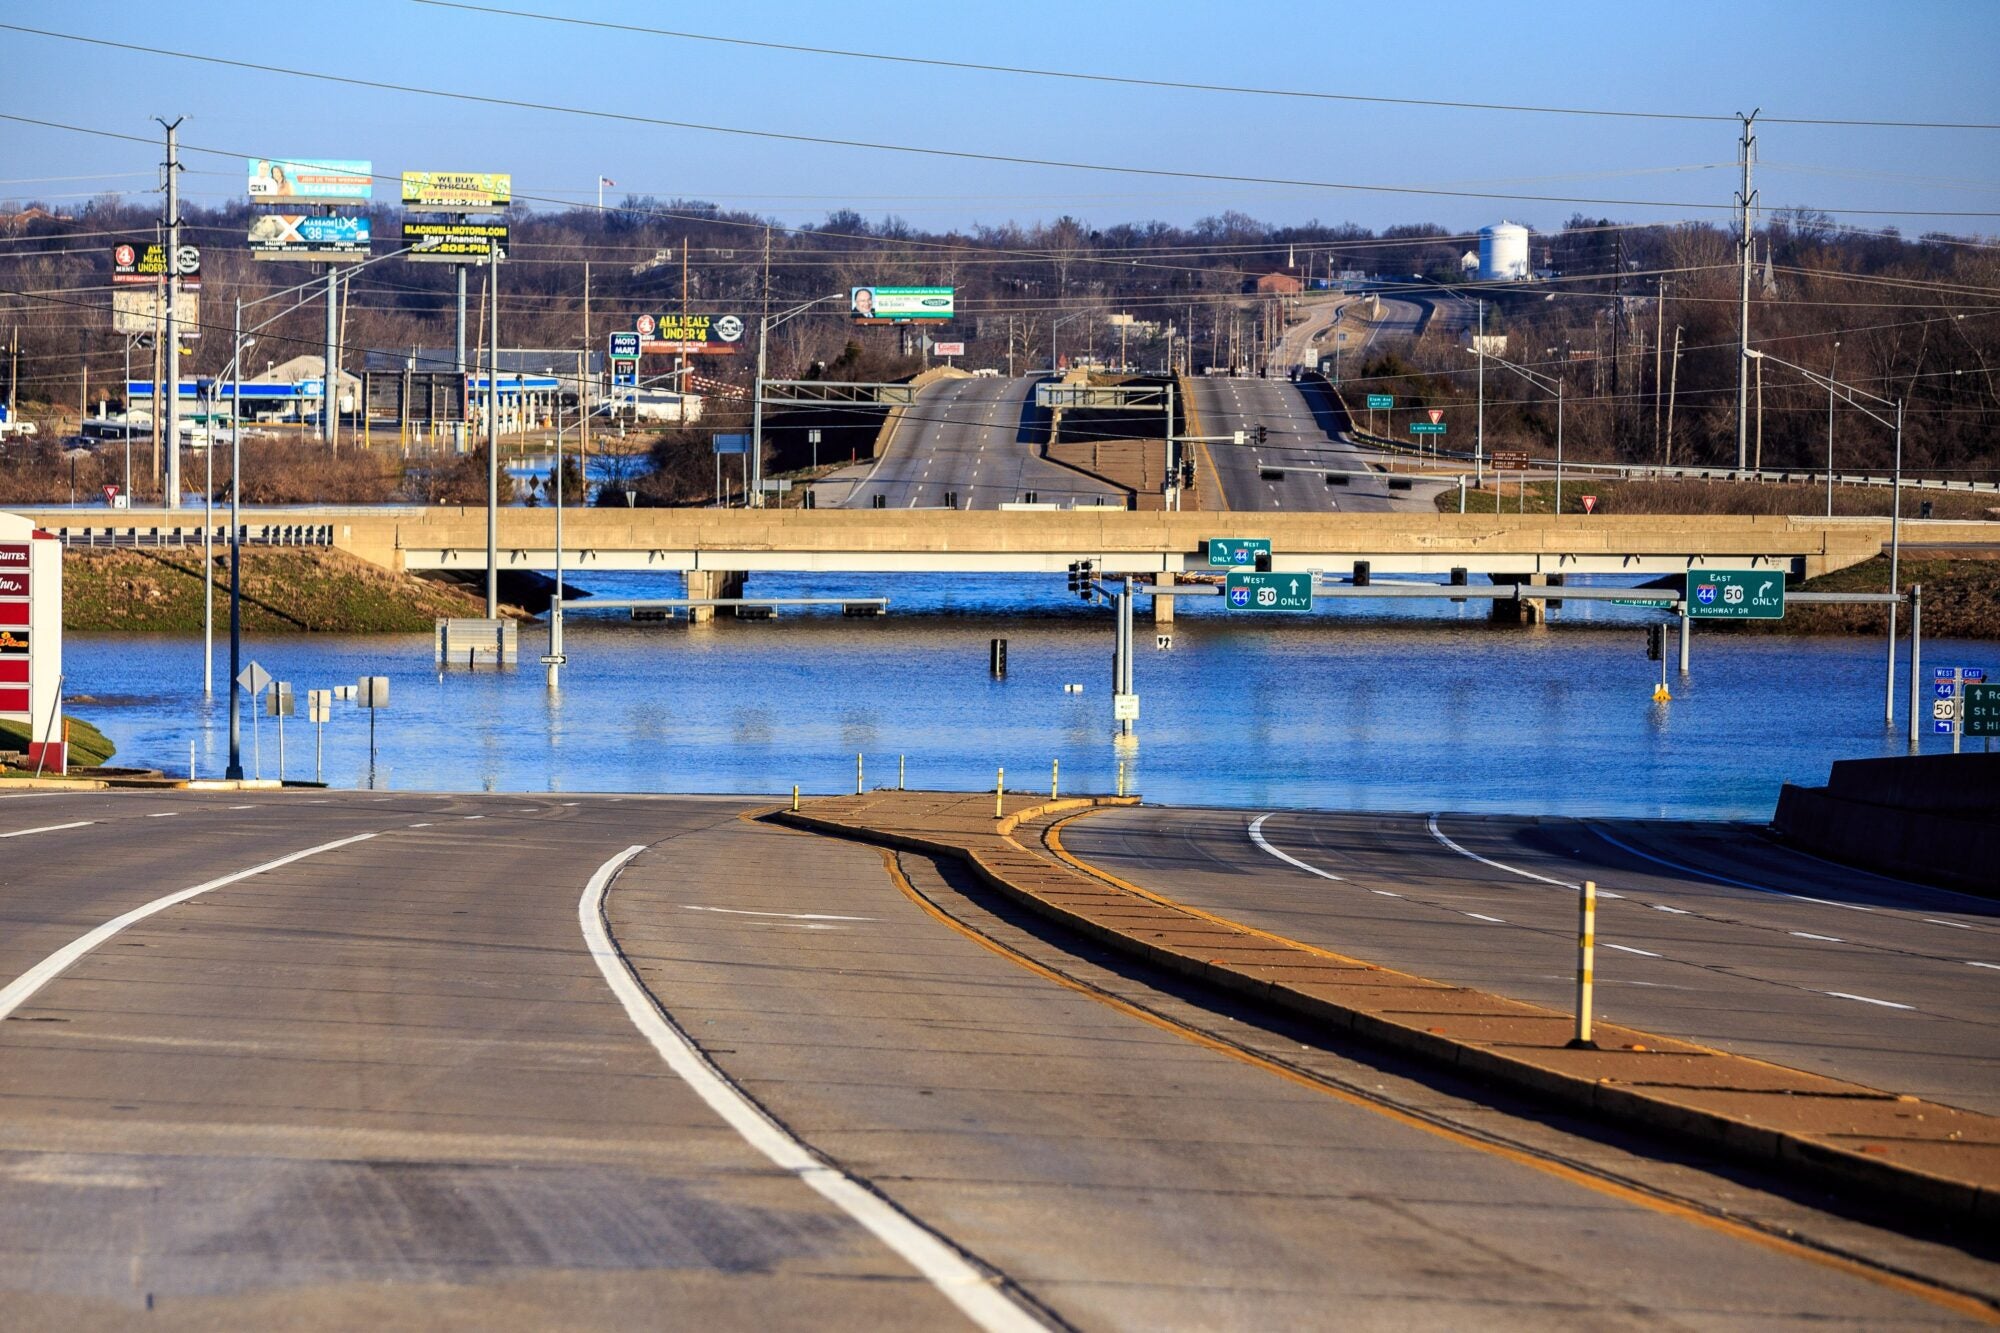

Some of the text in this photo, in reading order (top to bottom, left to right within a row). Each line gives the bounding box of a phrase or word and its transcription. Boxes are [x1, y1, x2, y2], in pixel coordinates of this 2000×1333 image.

[404, 225, 507, 236] BLACKWELLMOTORS.COM
[446, 235, 487, 243] Financing
[148, 245, 162, 254] ALL
[121, 249, 130, 262] 4
[143, 254, 167, 263] MEALS
[640, 319, 651, 331] 4
[660, 316, 677, 327] ALL
[1232, 591, 1275, 602] 44 50
[1699, 589, 1742, 600] 44 50
[1281, 598, 1307, 606] ONLY
[1752, 598, 1779, 606] ONLY
[1938, 685, 1951, 694] 44
[1936, 704, 1952, 715] 50
[1974, 707, 1986, 715] St
[1974, 721, 1981, 730] S
